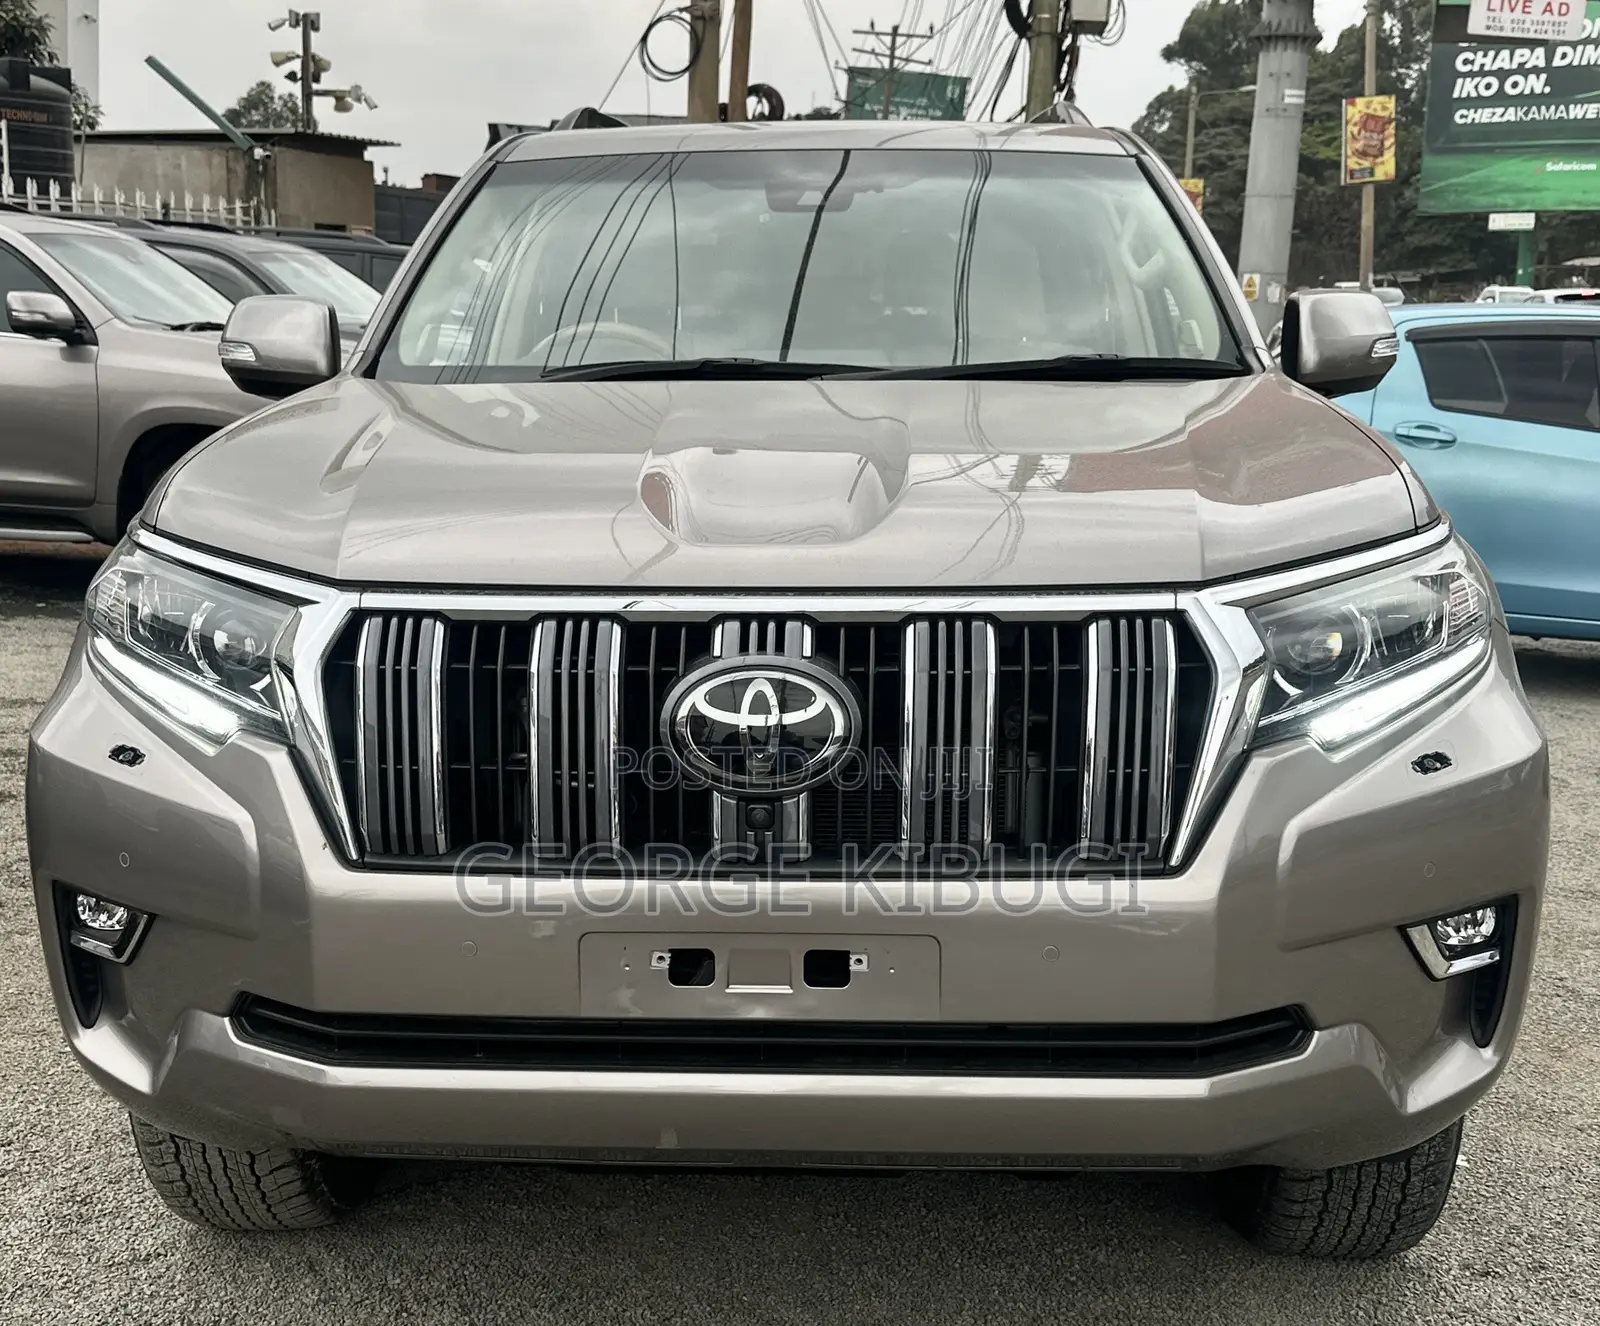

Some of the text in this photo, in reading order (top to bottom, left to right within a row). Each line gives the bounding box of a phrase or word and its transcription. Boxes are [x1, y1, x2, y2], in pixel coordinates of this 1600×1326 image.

[1486, 0, 1570, 17] LIVE AD
[1455, 47, 1546, 72] CHAPA
[1452, 73, 1551, 98] IKO ON.
[1454, 103, 1600, 124] CHEZAKAMAWE
[1546, 161, 1597, 172] Safaricom
